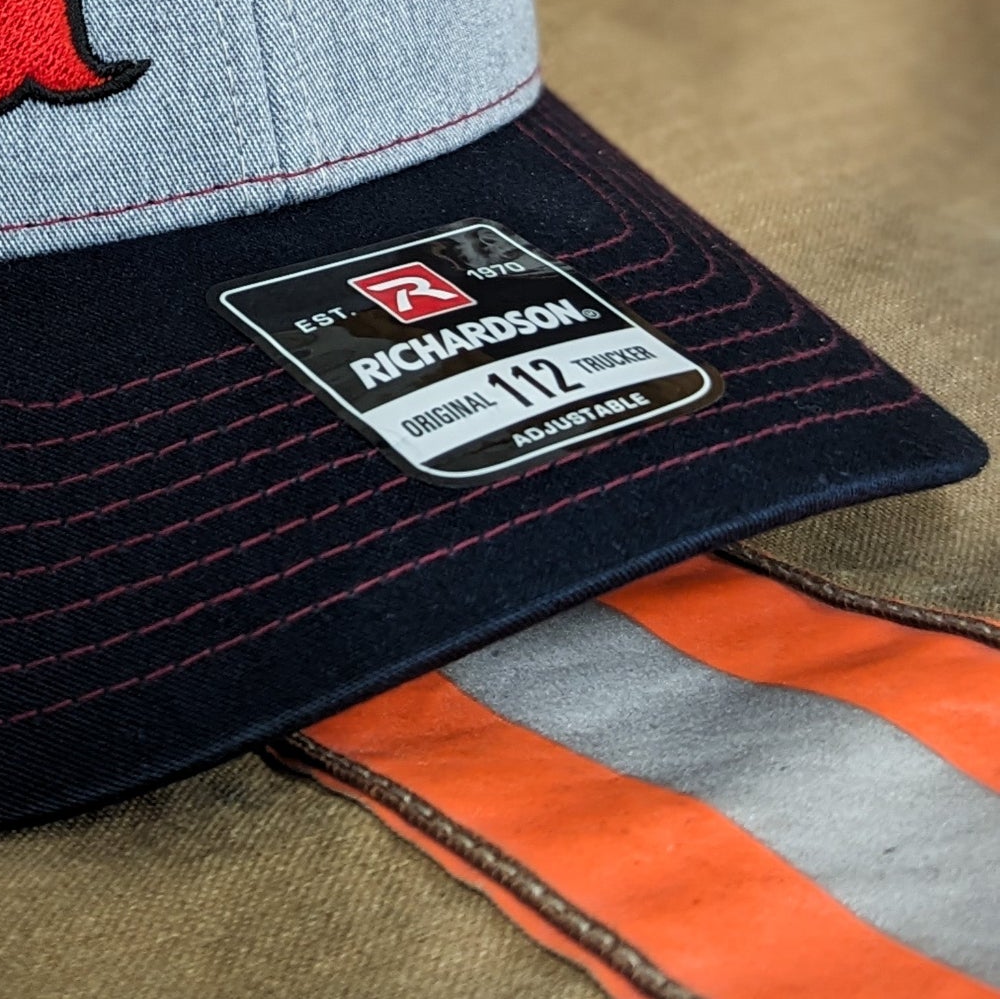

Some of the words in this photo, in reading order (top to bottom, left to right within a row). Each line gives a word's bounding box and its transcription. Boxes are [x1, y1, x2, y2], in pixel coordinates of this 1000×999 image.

[294, 307, 357, 334] EST.
[466, 261, 526, 280] 1970
[401, 392, 497, 437] ORIGINAL
[487, 358, 585, 408] 112
[570, 345, 657, 374] TRUCKER
[511, 392, 651, 448] ADJUSTABLE
